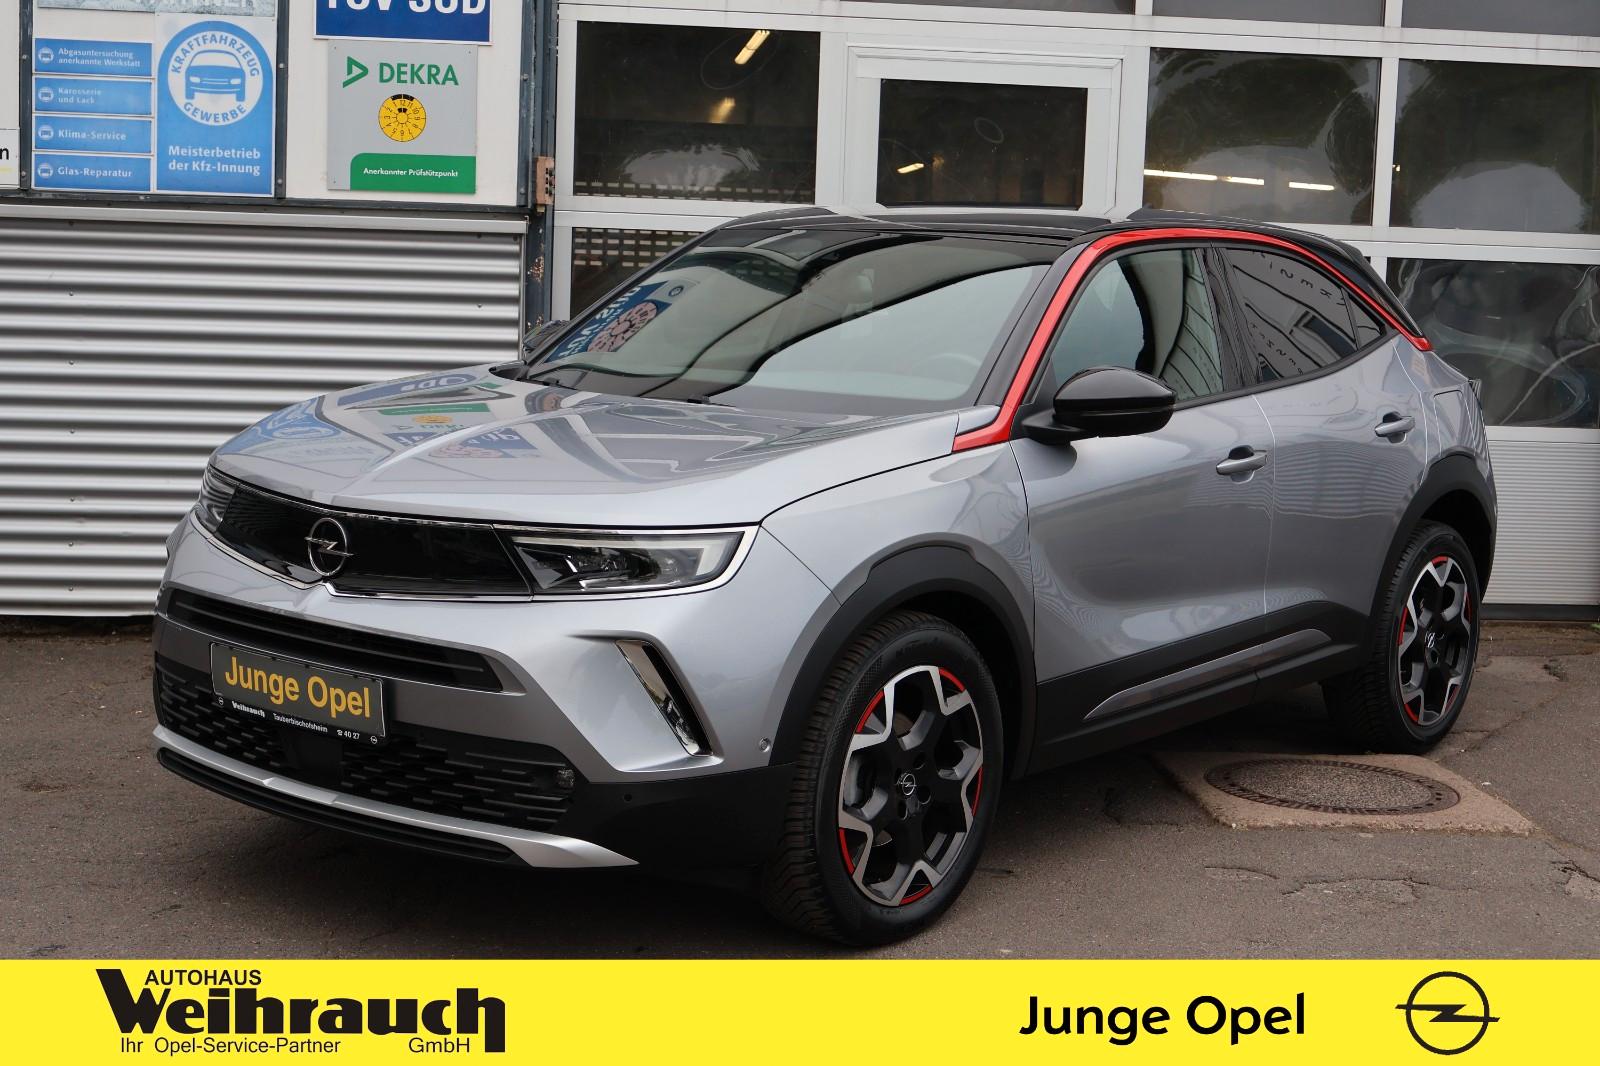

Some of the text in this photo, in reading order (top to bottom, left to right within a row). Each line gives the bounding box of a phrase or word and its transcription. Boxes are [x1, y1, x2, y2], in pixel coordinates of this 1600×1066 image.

[58, 47, 134, 60] Abgasuntersuchung
[170, 33, 260, 77] KRAFTFAHRZEUG
[58, 57, 141, 67] anerkannte Werkstatt
[379, 62, 459, 86] DEKRA
[58, 96, 74, 104] und
[184, 102, 247, 123] GEWERBE
[58, 129, 127, 141] Klima-Service
[168, 145, 261, 160] Meisterbetrieb
[57, 167, 133, 178] Glas-Reparatur
[168, 160, 261, 176] der Kfz-Innung
[363, 168, 459, 178] Anerkannter Prüfstützpunkt
[225, 656, 371, 719] Junge Opel
[273, 712, 329, 733] Tauberbischofsheim
[343, 730, 352, 738] 40
[352, 731, 360, 740] 27
